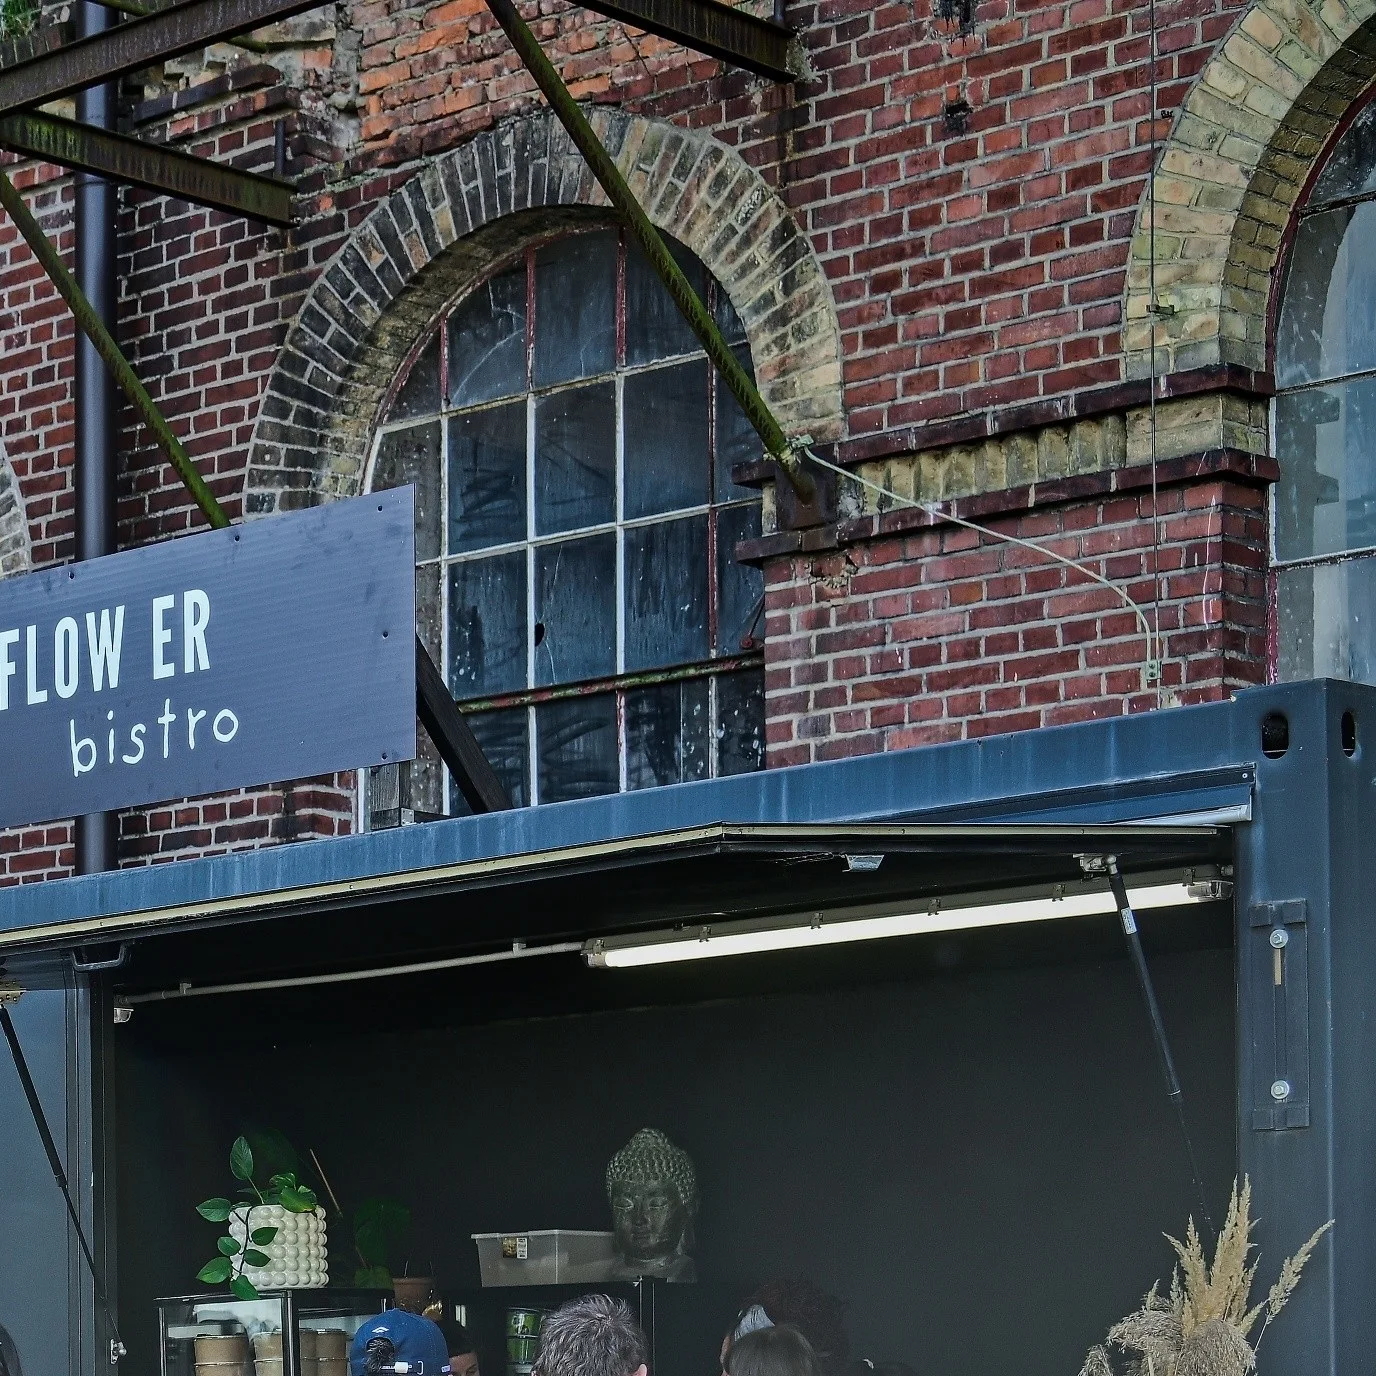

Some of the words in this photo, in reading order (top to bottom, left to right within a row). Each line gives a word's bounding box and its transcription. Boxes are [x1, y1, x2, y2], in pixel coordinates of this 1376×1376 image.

[0, 605, 125, 711] FLOW
[152, 589, 211, 680] ER
[70, 698, 239, 777] bistro
